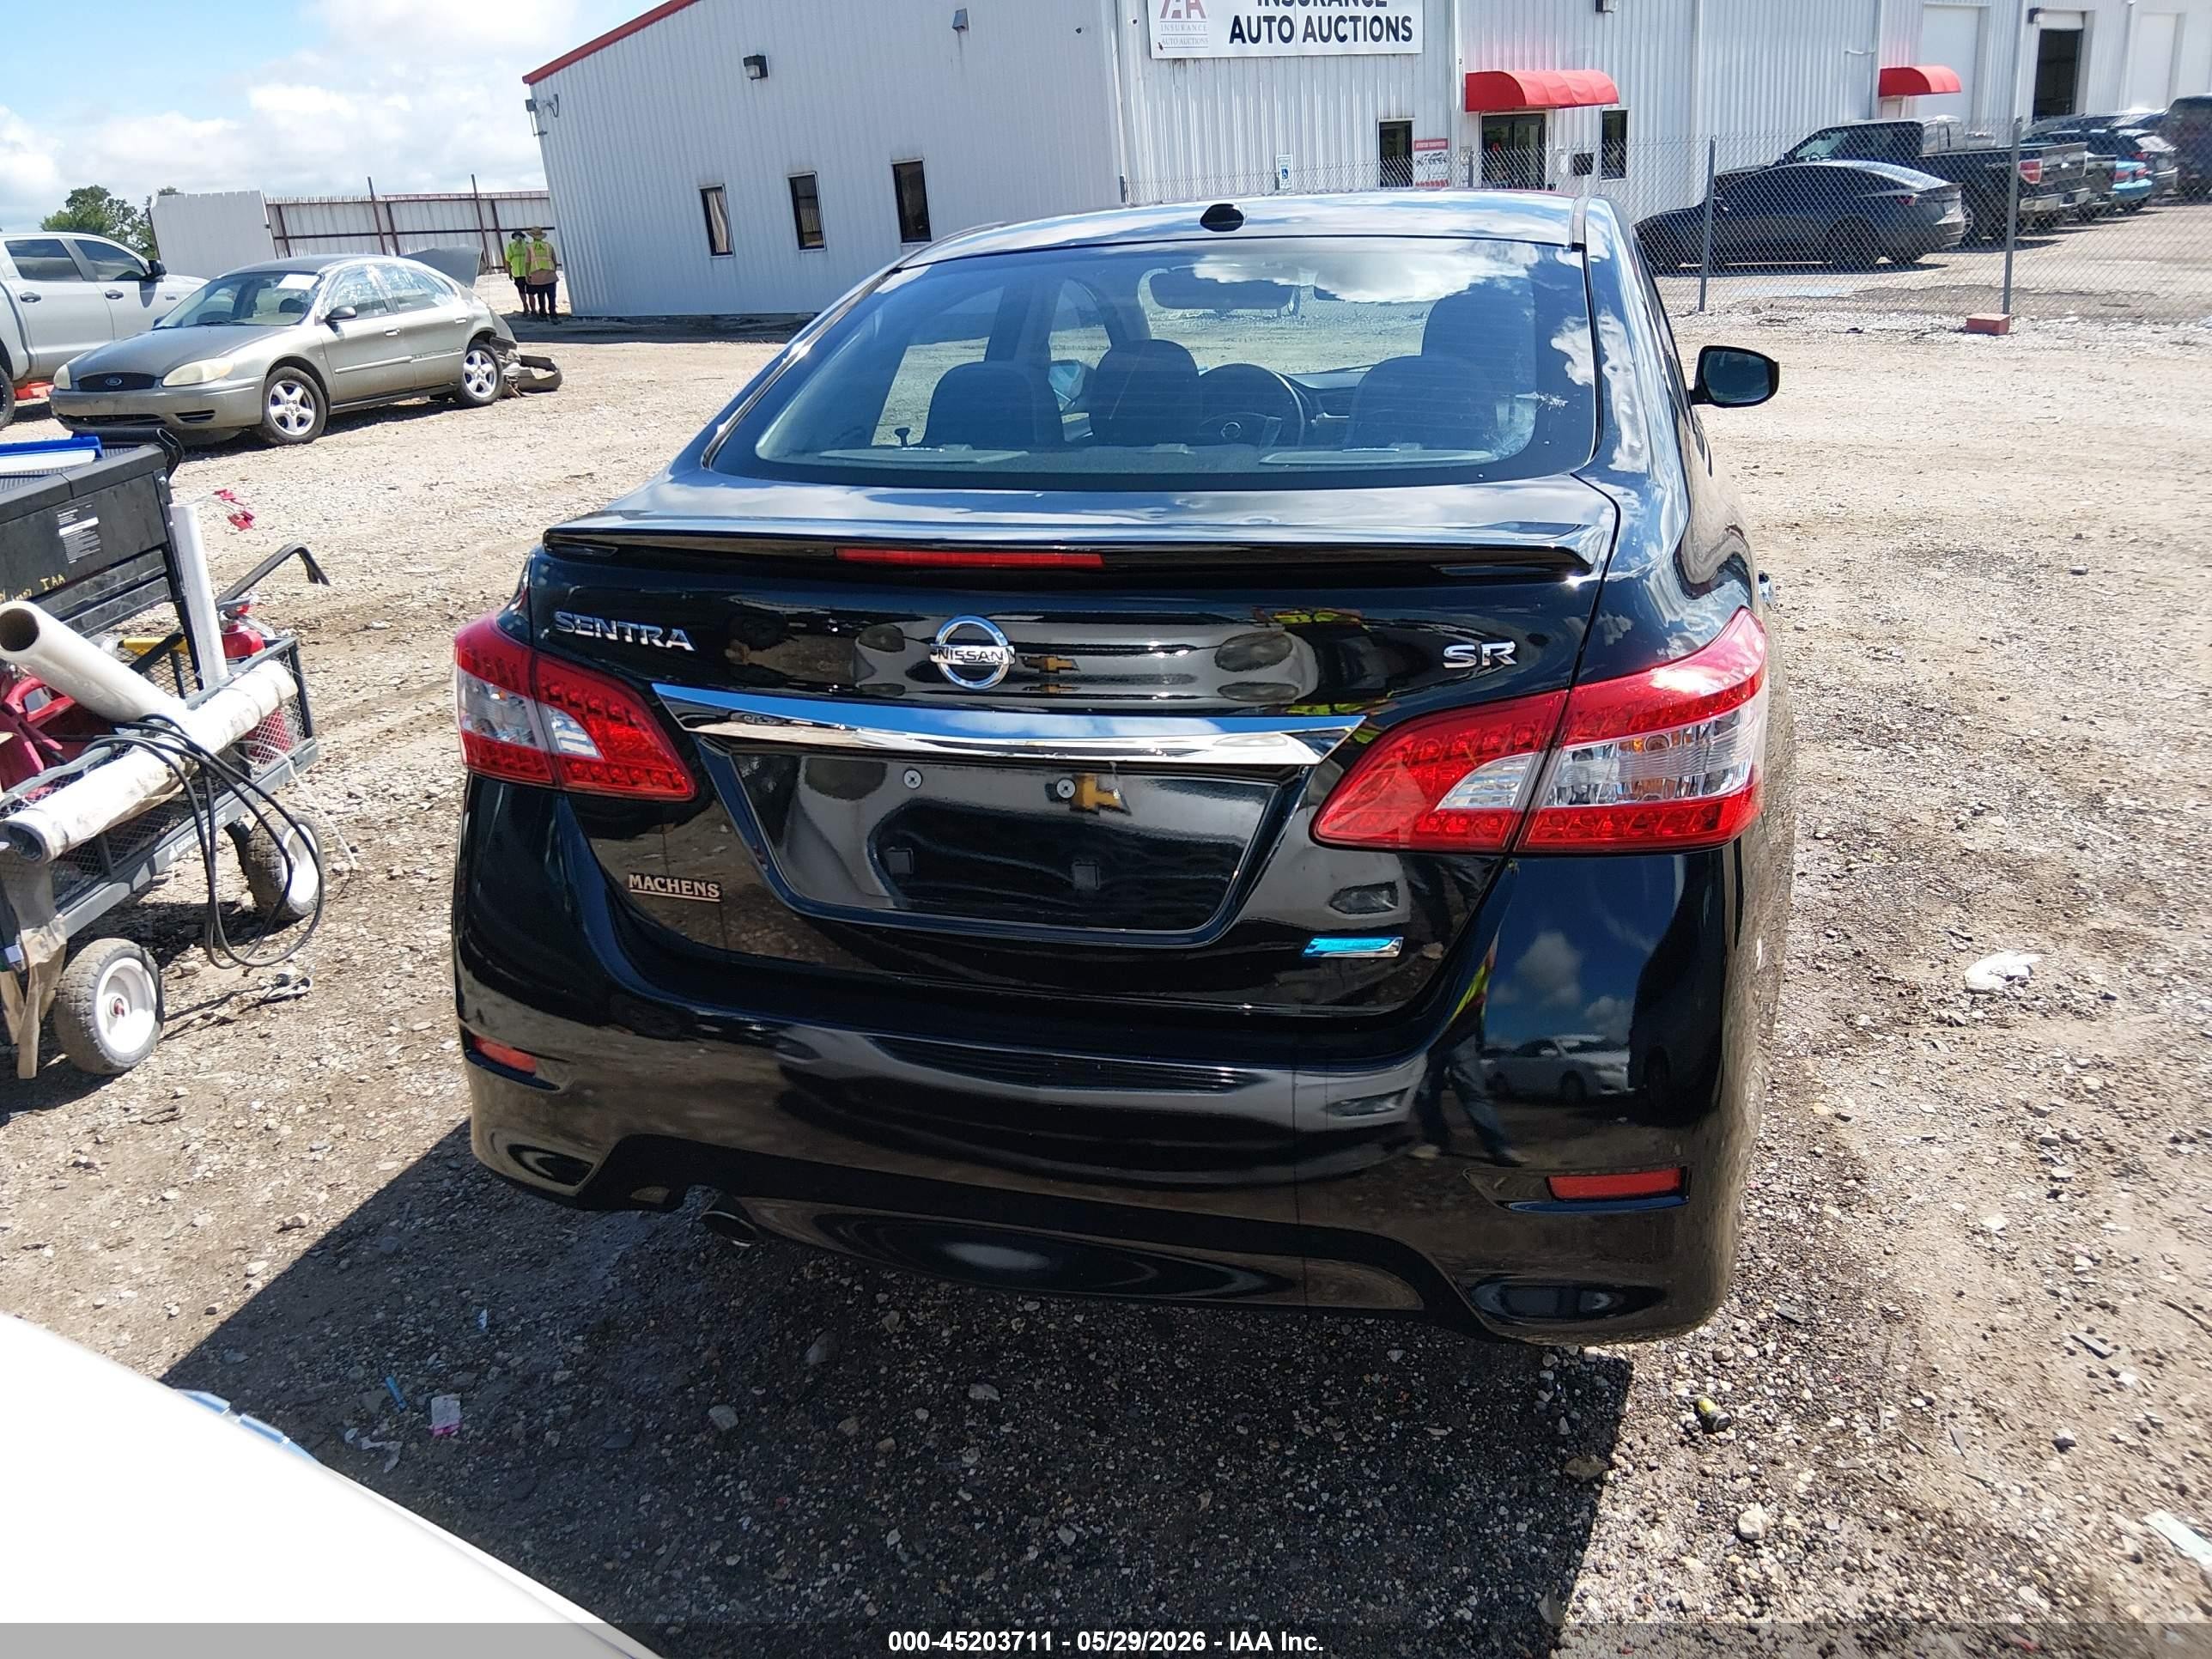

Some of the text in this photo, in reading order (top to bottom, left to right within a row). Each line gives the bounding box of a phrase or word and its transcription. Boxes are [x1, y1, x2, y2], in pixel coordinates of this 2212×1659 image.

[1161, 23, 1206, 32] INSURANCE
[1229, 15, 1413, 44] AUTO AUCTIONS
[555, 611, 695, 652] SENTRA
[938, 647, 1004, 662] NISSAN
[1443, 641, 1517, 668] SR
[629, 873, 720, 898] MACHENS
